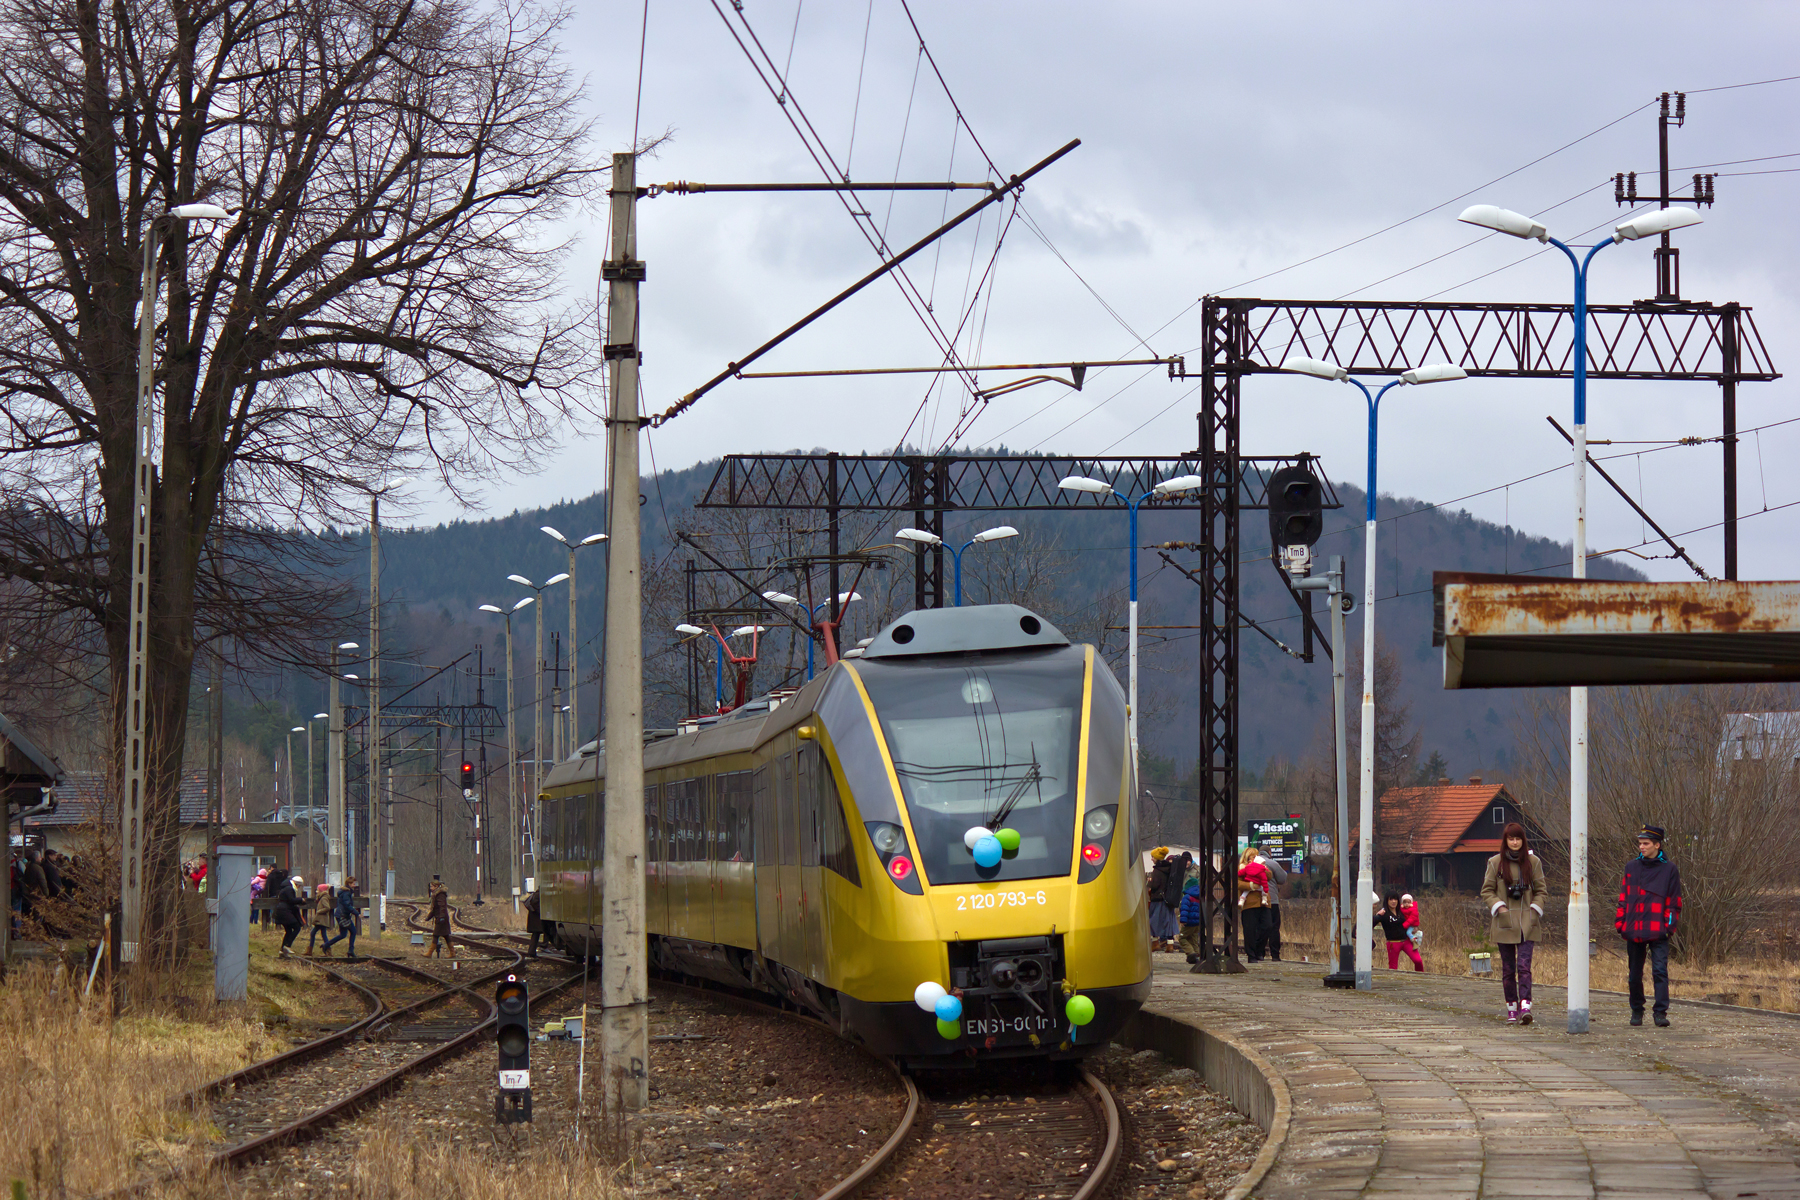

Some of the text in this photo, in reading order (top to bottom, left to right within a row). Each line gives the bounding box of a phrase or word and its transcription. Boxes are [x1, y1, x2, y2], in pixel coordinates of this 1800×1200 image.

[1259, 822, 1293, 832] silesia
[956, 890, 1046, 911] 2 120 793-6
